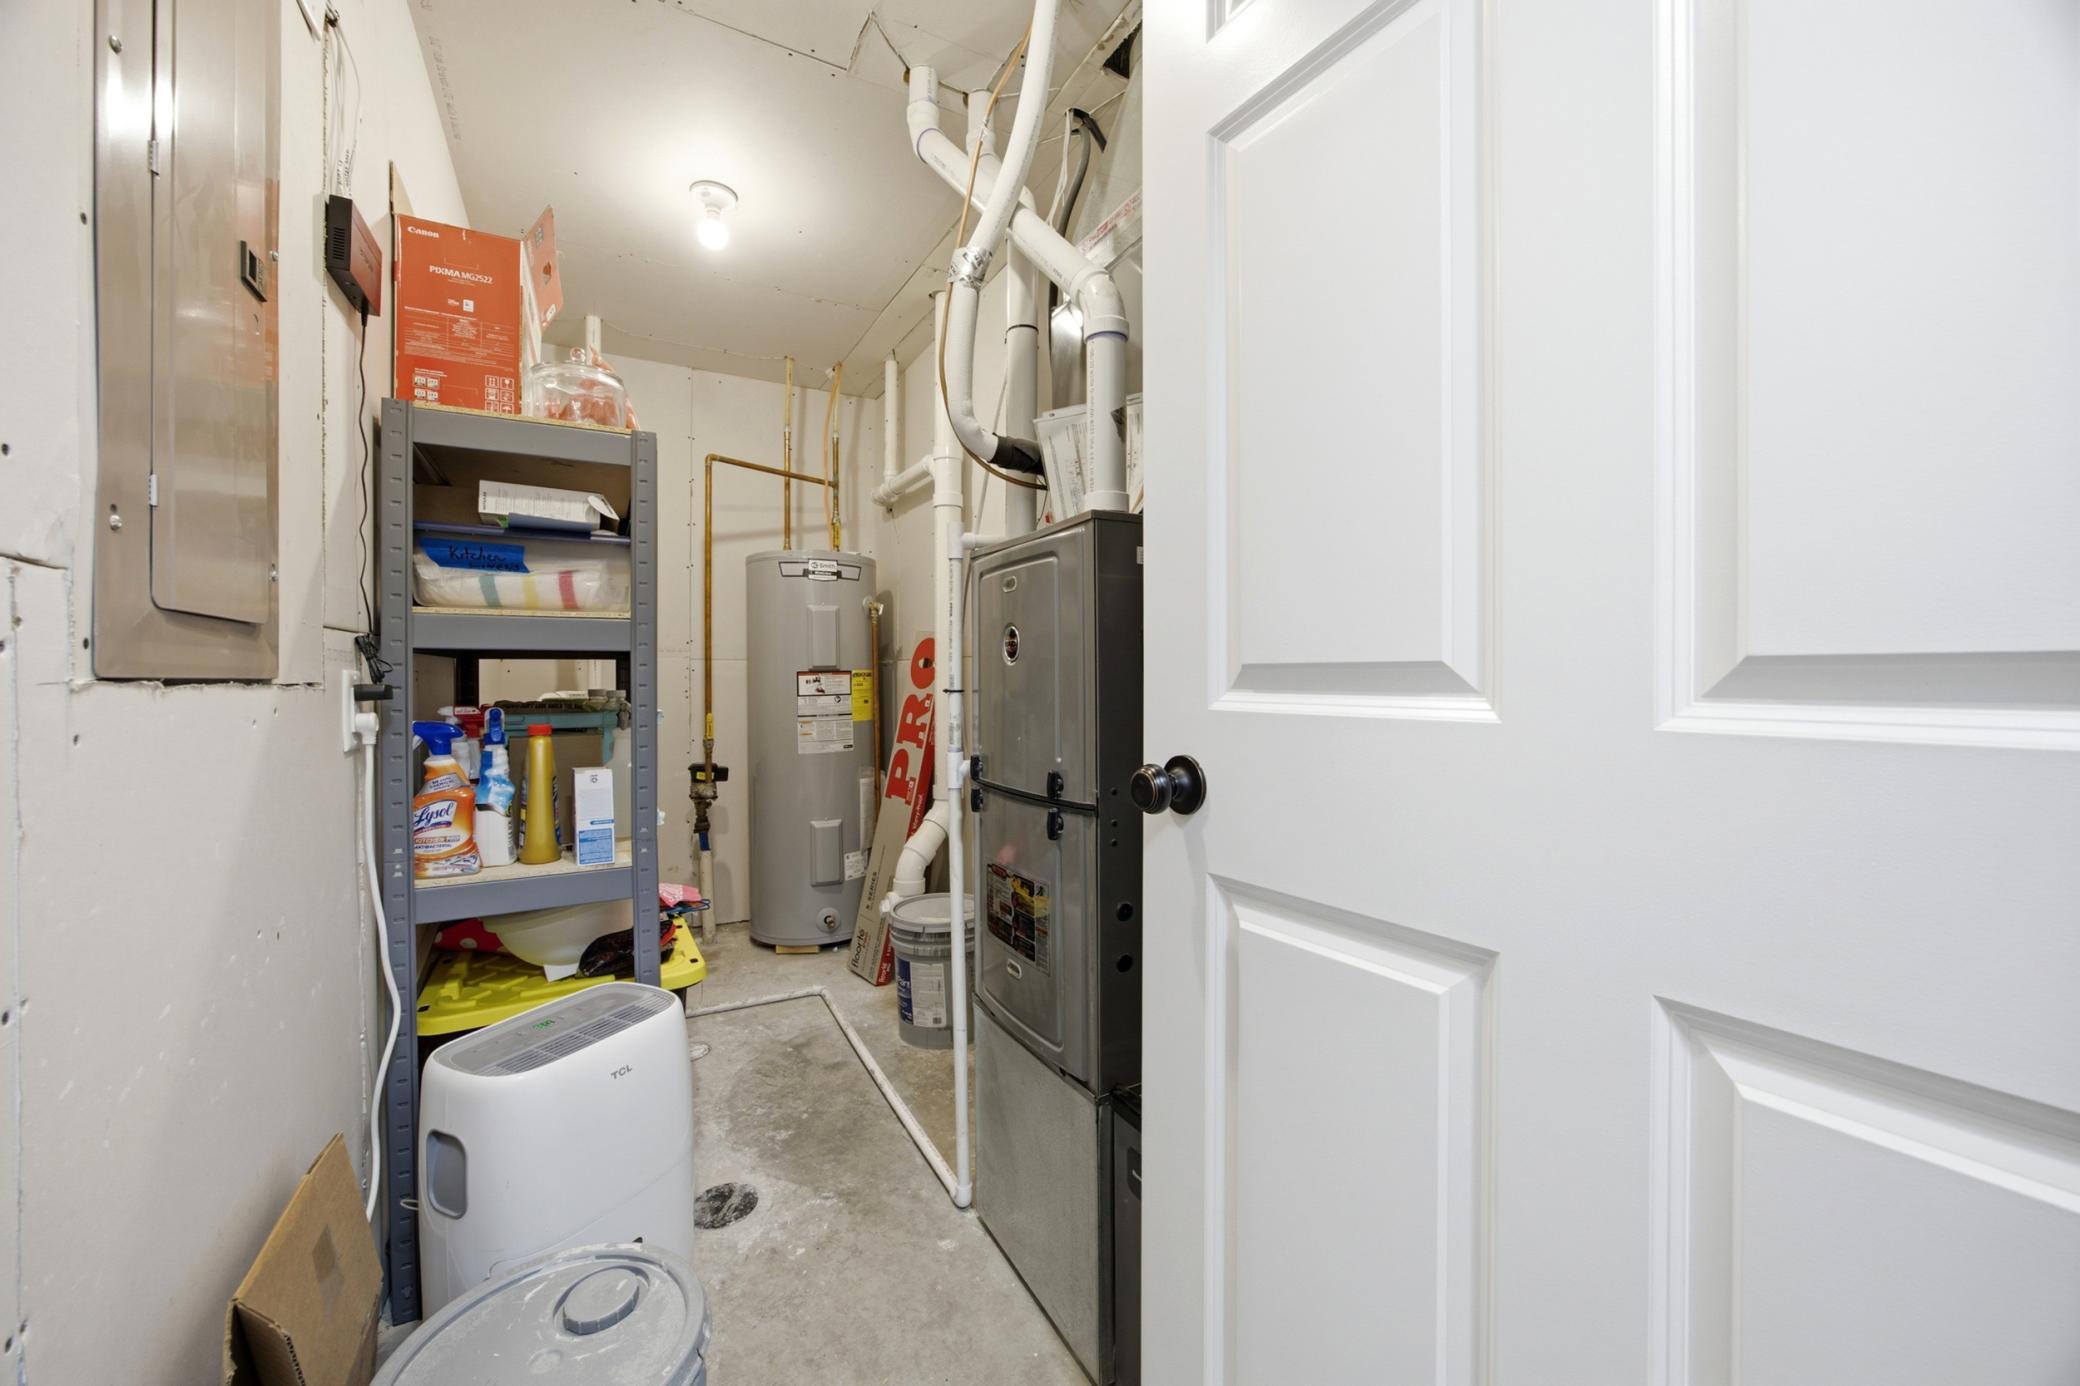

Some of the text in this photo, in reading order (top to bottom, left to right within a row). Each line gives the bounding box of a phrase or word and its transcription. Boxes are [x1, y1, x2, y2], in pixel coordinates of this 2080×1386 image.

[407, 226, 440, 239] Canon
[429, 265, 494, 285] PIXMA MG2522
[448, 543, 507, 562] Kitchen
[414, 802, 454, 827] Lysol
[610, 1064, 633, 1080] TCL
